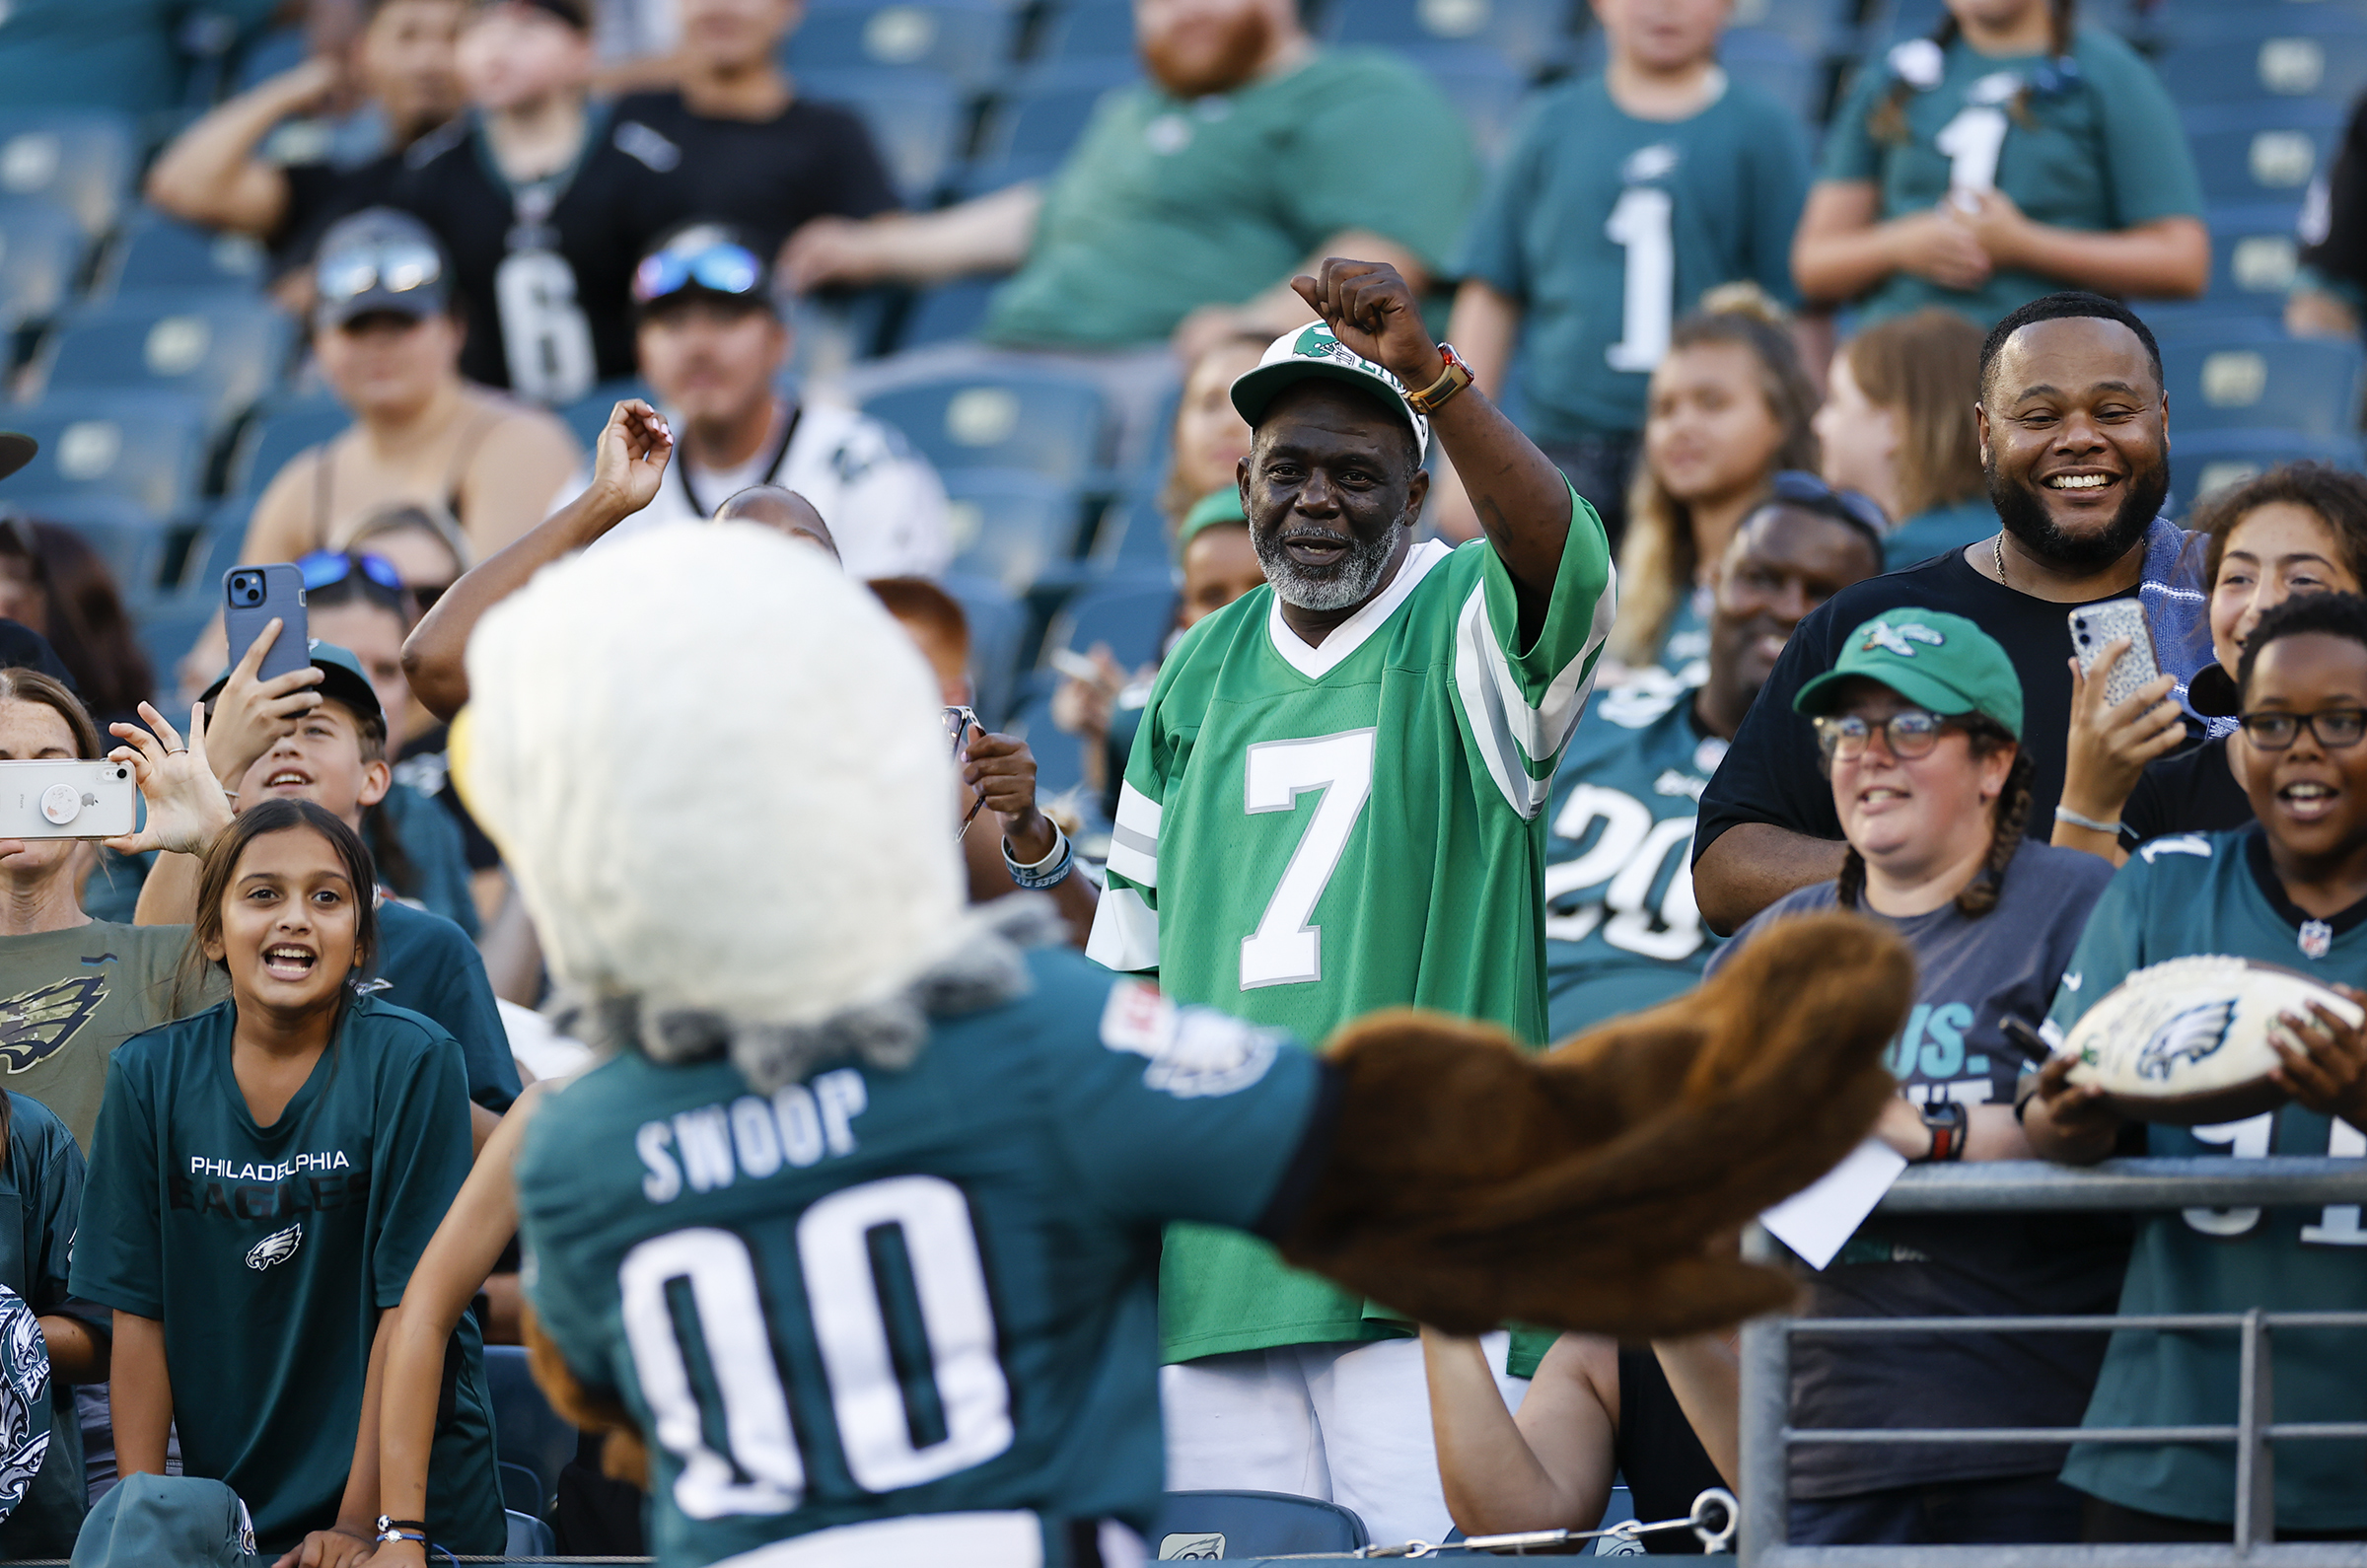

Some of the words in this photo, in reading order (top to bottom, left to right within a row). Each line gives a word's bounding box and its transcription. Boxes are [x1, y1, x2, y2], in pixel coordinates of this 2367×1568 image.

[494, 250, 598, 404] 6
[1606, 187, 1675, 373] 1
[1240, 727, 1377, 992] 7
[1545, 784, 1703, 961] 20
[168, 1172, 371, 1221] EAGLES
[190, 1150, 350, 1182] PHILADELPHIA
[635, 1068, 868, 1204] SWOOP
[618, 1174, 1015, 1520] 00
